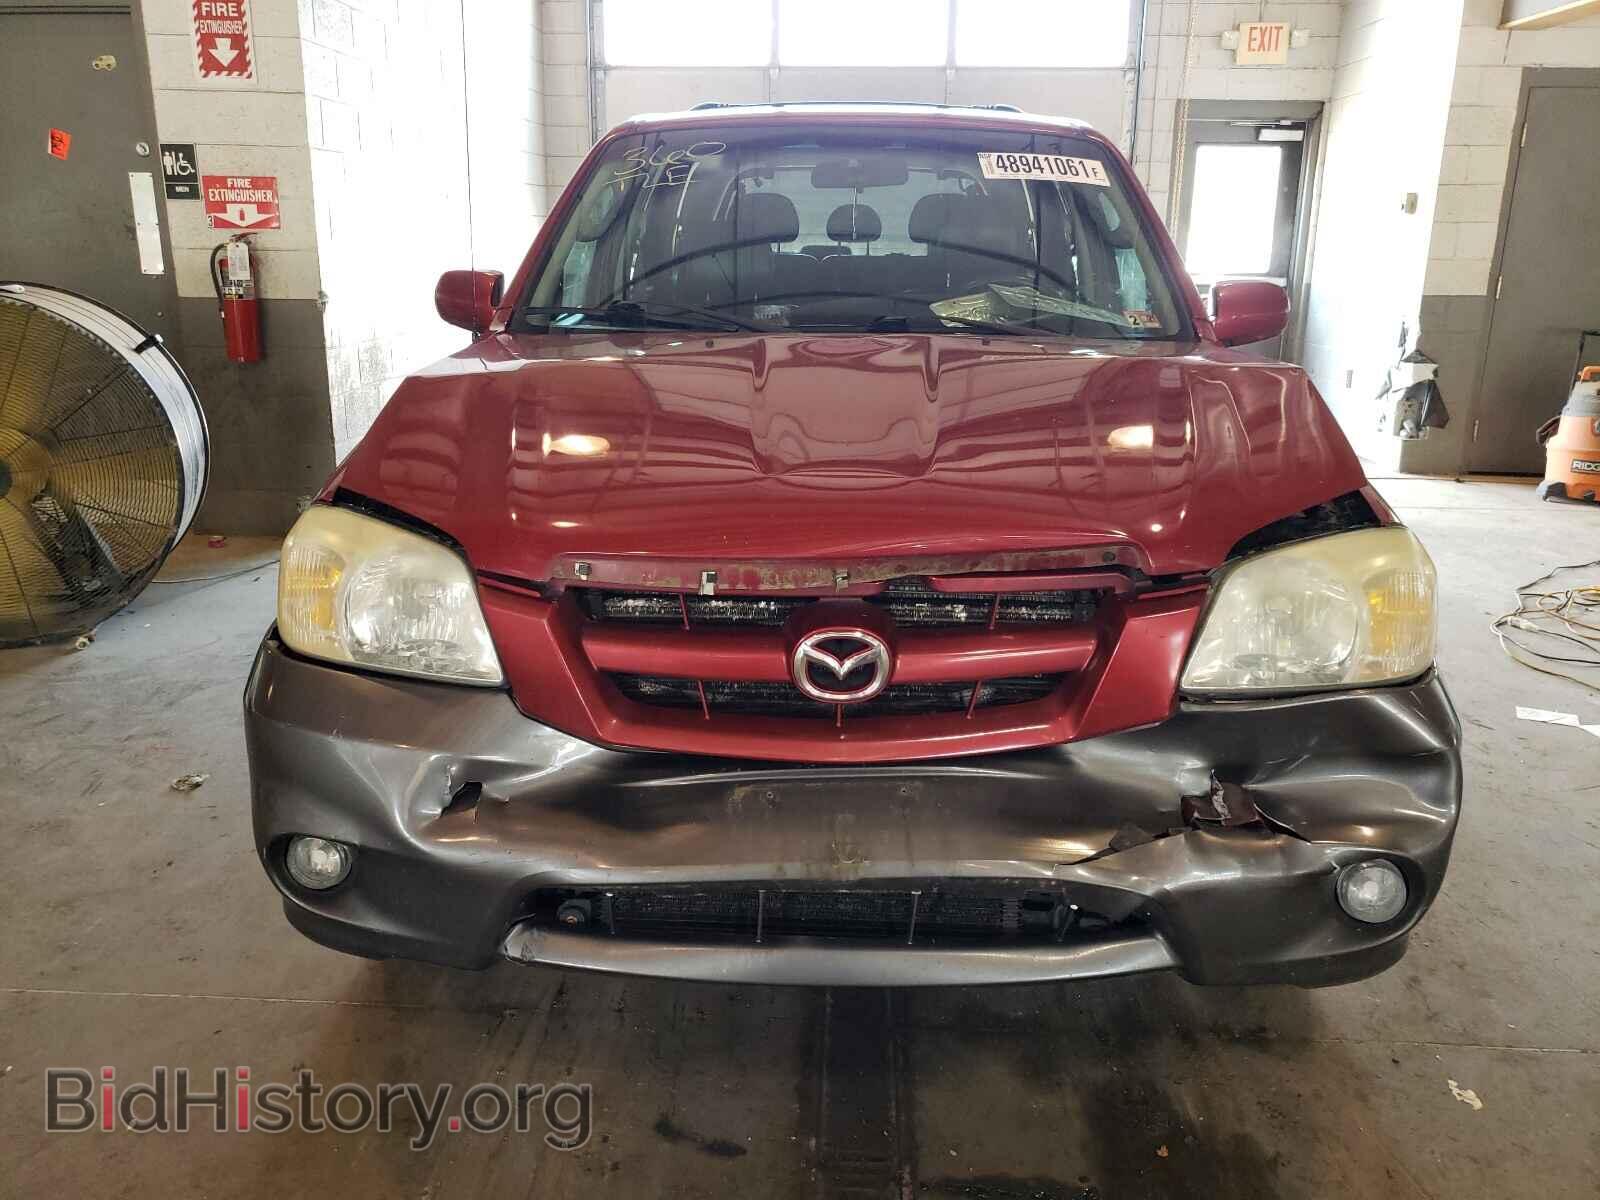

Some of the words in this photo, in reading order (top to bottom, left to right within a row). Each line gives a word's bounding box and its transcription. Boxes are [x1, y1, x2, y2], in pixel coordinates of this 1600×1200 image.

[201, 2, 239, 17] FIRE
[199, 19, 243, 34] EXTINGUISHER
[1247, 25, 1283, 52] EXIT
[996, 154, 1090, 178] 48941061
[226, 178, 252, 189] FIRE
[208, 188, 273, 202] EXTINGUISHER
